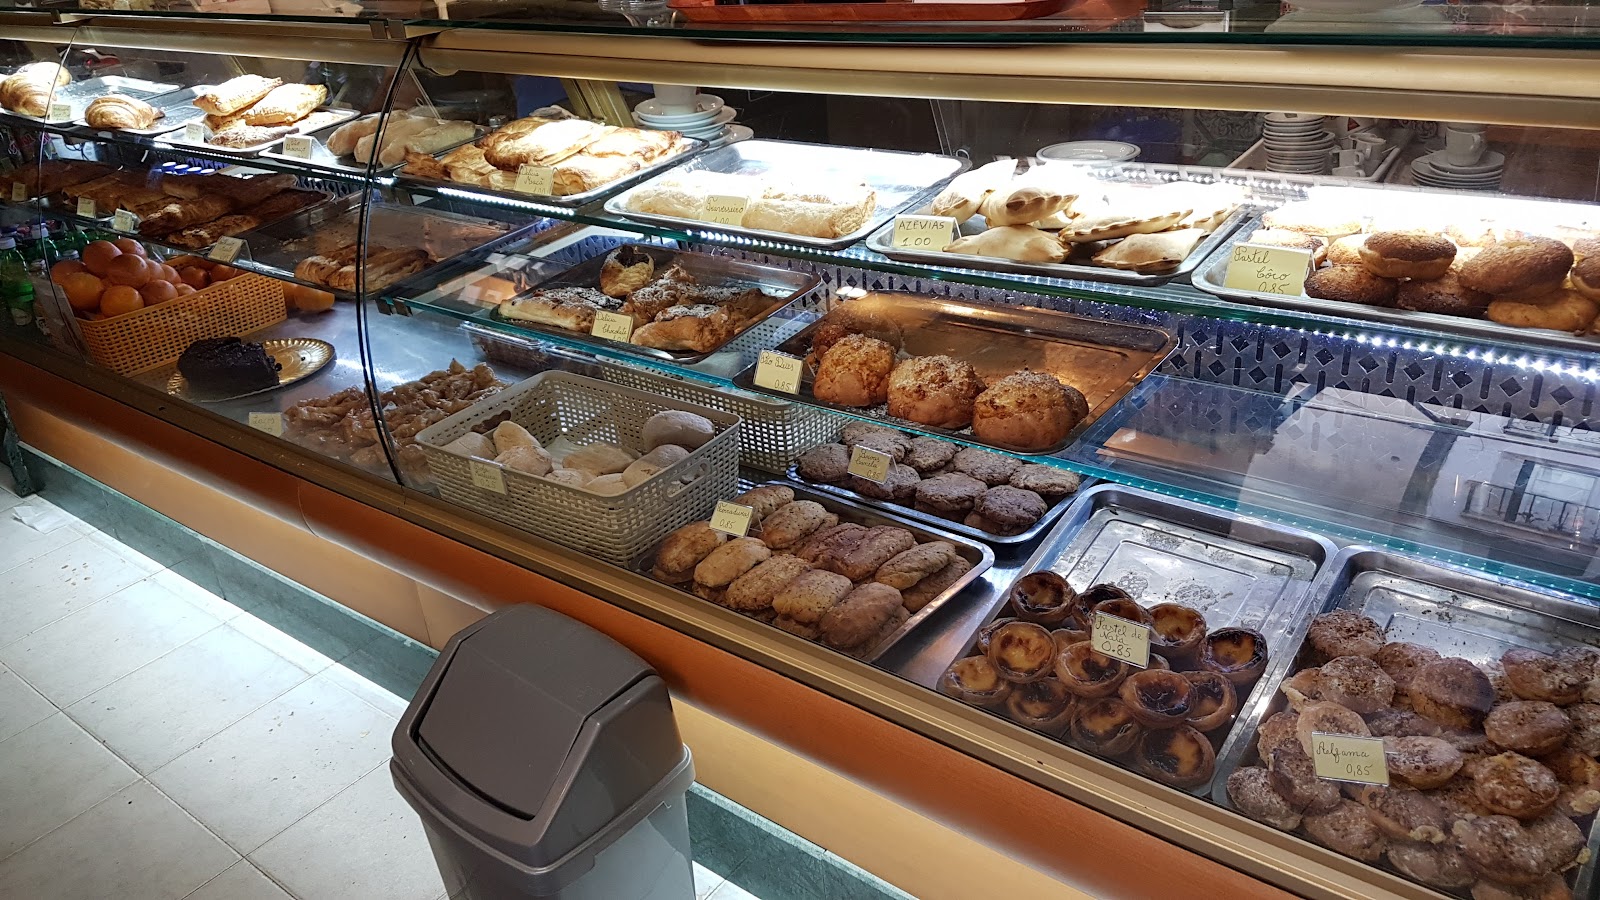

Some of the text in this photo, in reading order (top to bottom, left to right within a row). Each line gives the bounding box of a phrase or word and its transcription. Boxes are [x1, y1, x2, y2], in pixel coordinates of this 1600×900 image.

[898, 220, 945, 230] AZEVIAS
[1234, 246, 1271, 264] Pastel
[1095, 616, 1142, 640] Pastel de
[1100, 631, 1129, 646] Nata
[1101, 640, 1131, 658] 0.85
[1346, 763, 1373, 776] 0,85
